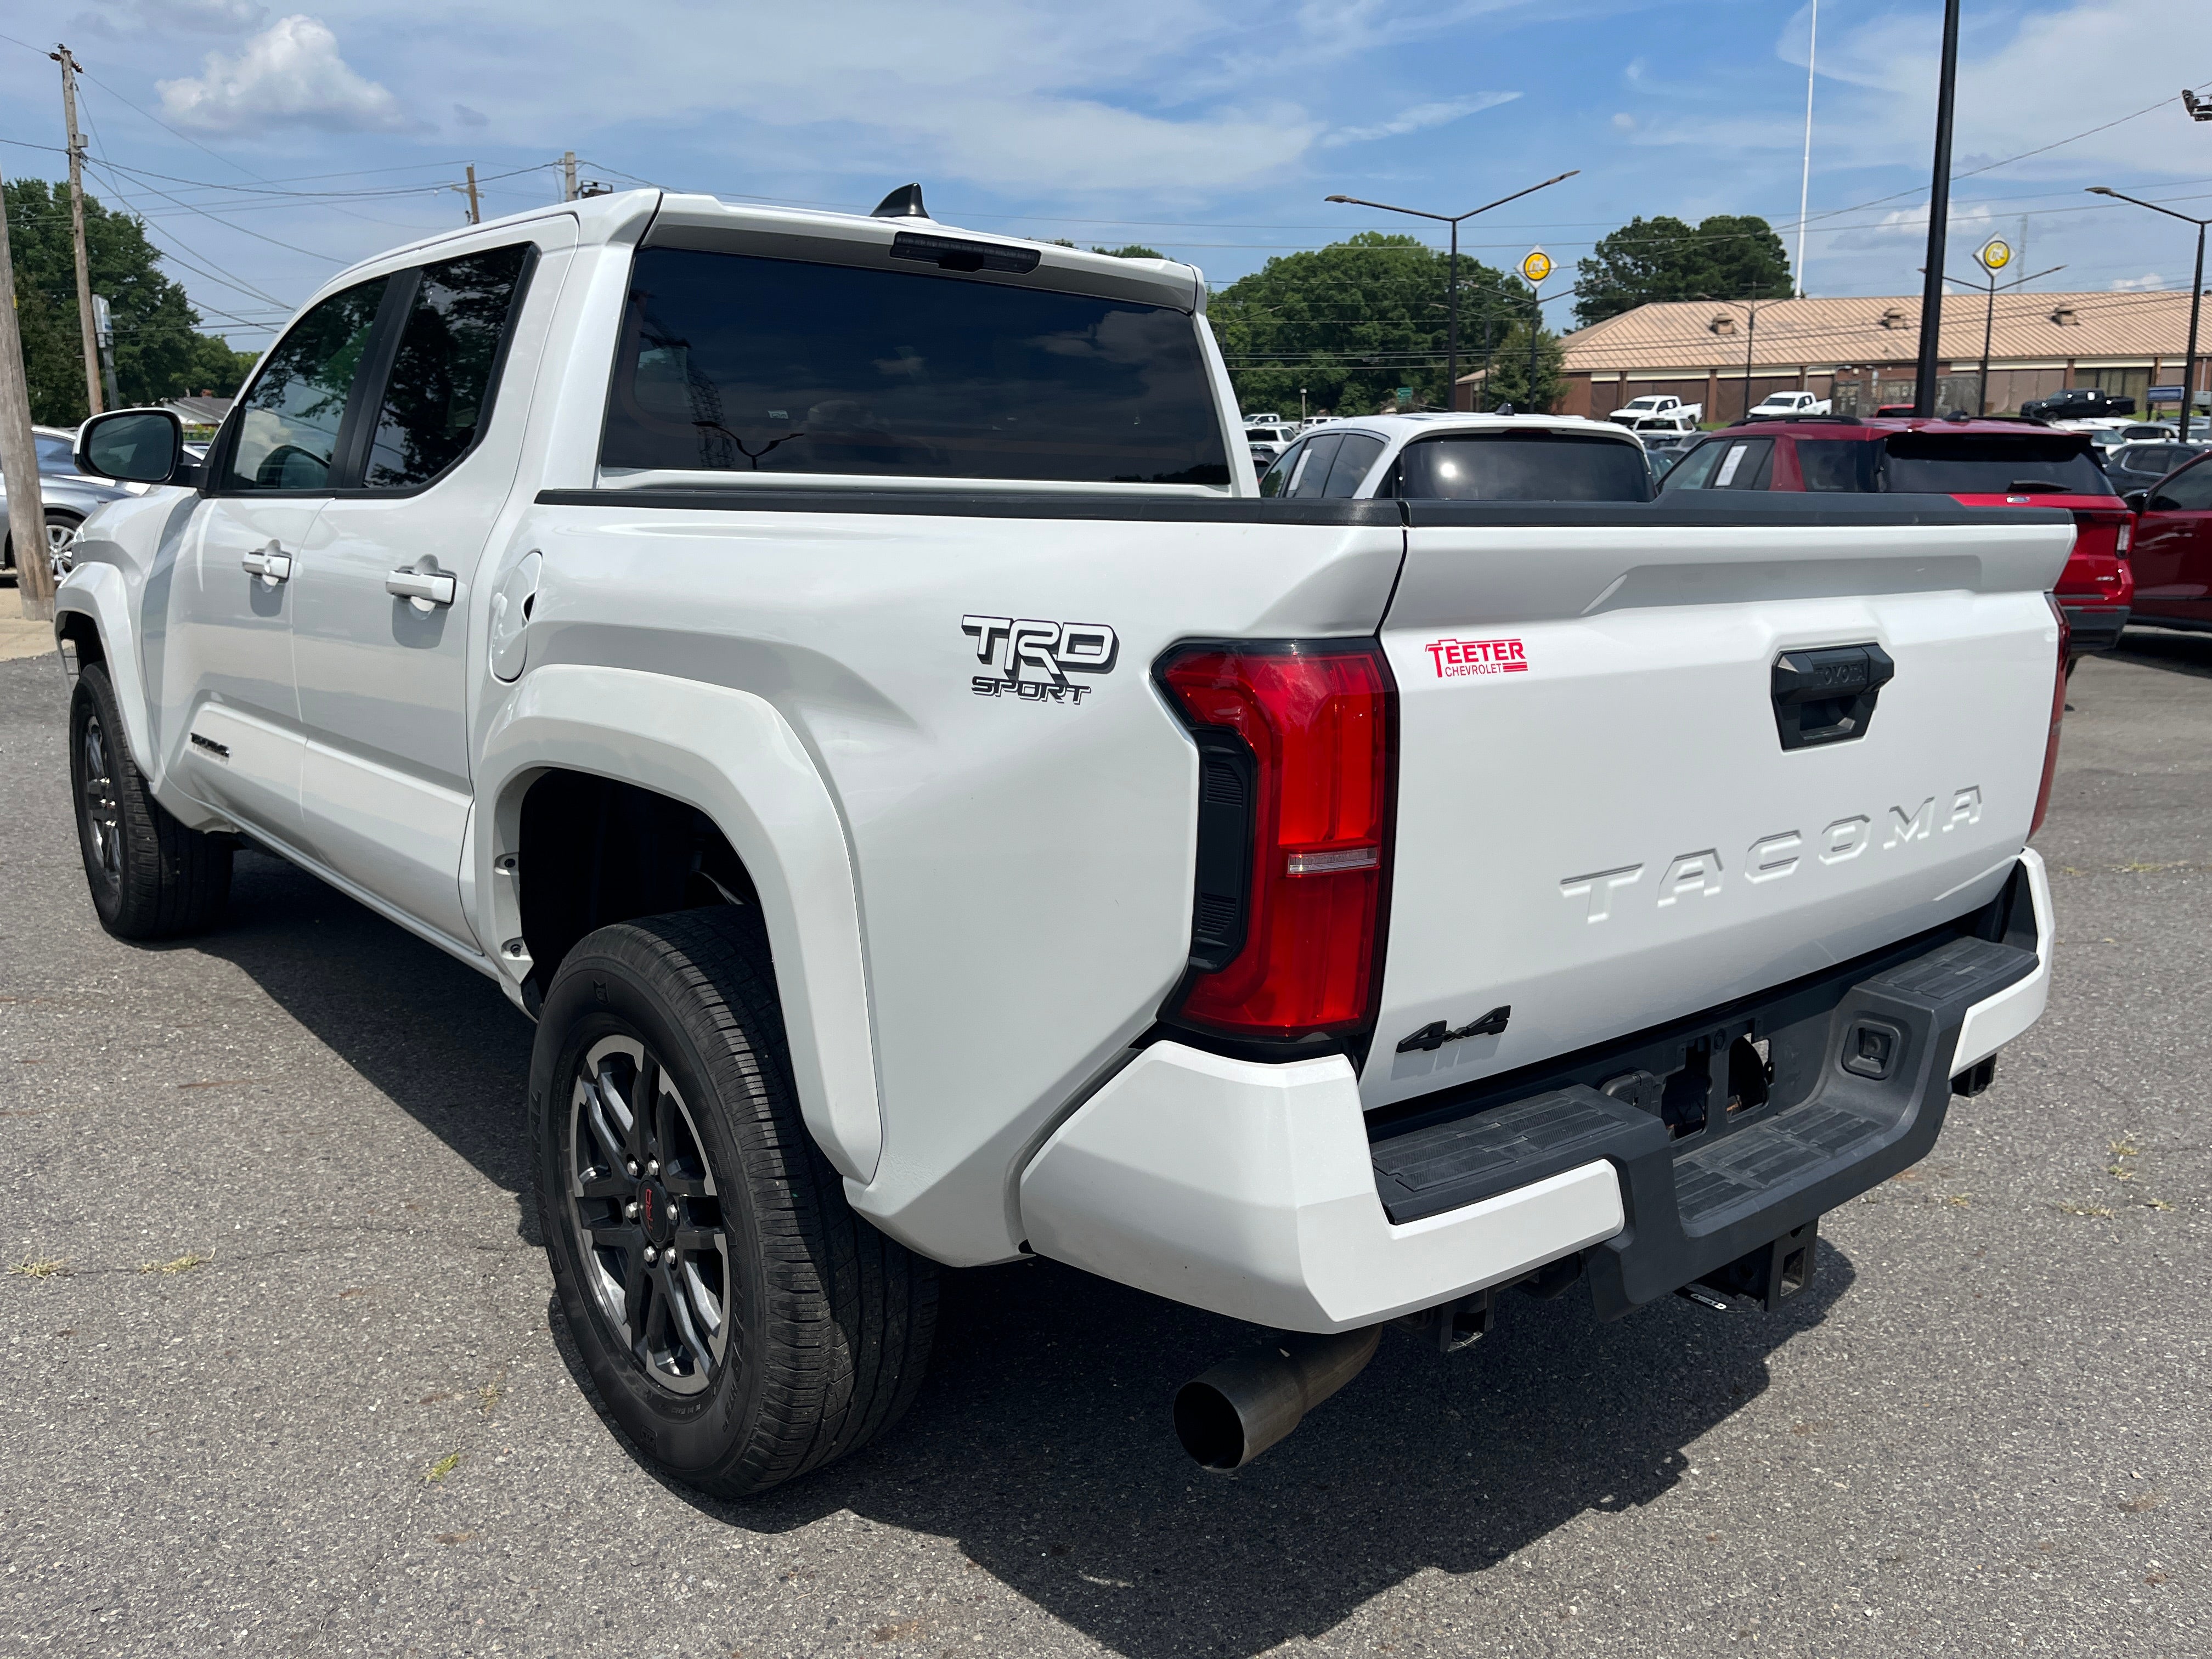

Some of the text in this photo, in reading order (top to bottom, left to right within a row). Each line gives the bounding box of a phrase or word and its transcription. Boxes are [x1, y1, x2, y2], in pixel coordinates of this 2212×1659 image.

[961, 614, 1120, 685] TRD
[1427, 642, 1526, 678] TEETER
[1445, 663, 1502, 678] CHEVROLET
[1815, 663, 1865, 686] TOYOTA
[972, 676, 1092, 705] SPORT
[1559, 785, 1983, 924] TACOMA
